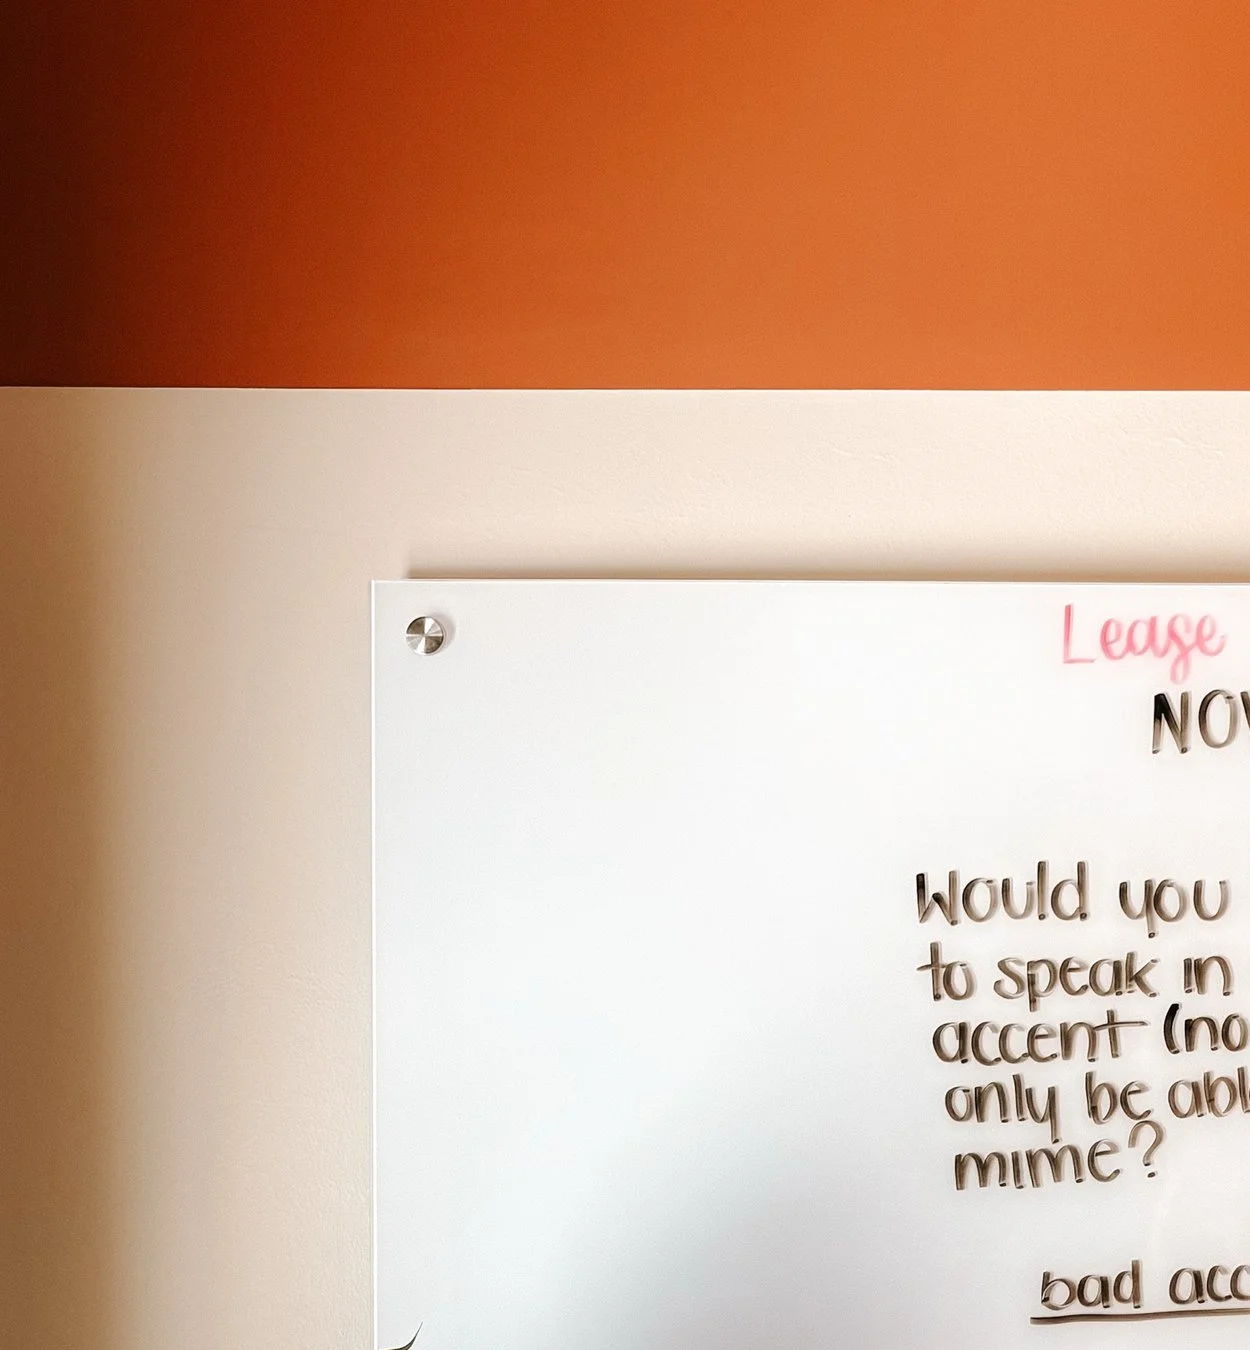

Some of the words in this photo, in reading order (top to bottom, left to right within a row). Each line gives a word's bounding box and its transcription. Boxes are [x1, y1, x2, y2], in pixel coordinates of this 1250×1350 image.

[1061, 602, 1227, 684] Lease
[915, 860, 1091, 927] Would
[1118, 878, 1231, 940] you
[915, 941, 977, 1002] to
[992, 951, 1160, 1013] speak
[1182, 955, 1235, 997] in
[931, 1008, 1150, 1067] accent
[1162, 1002, 1250, 1055] (no
[944, 1073, 1064, 1145] only
[1084, 1070, 1155, 1126] be
[954, 1119, 1166, 1192] mime?
[1040, 1258, 1145, 1312] bad
